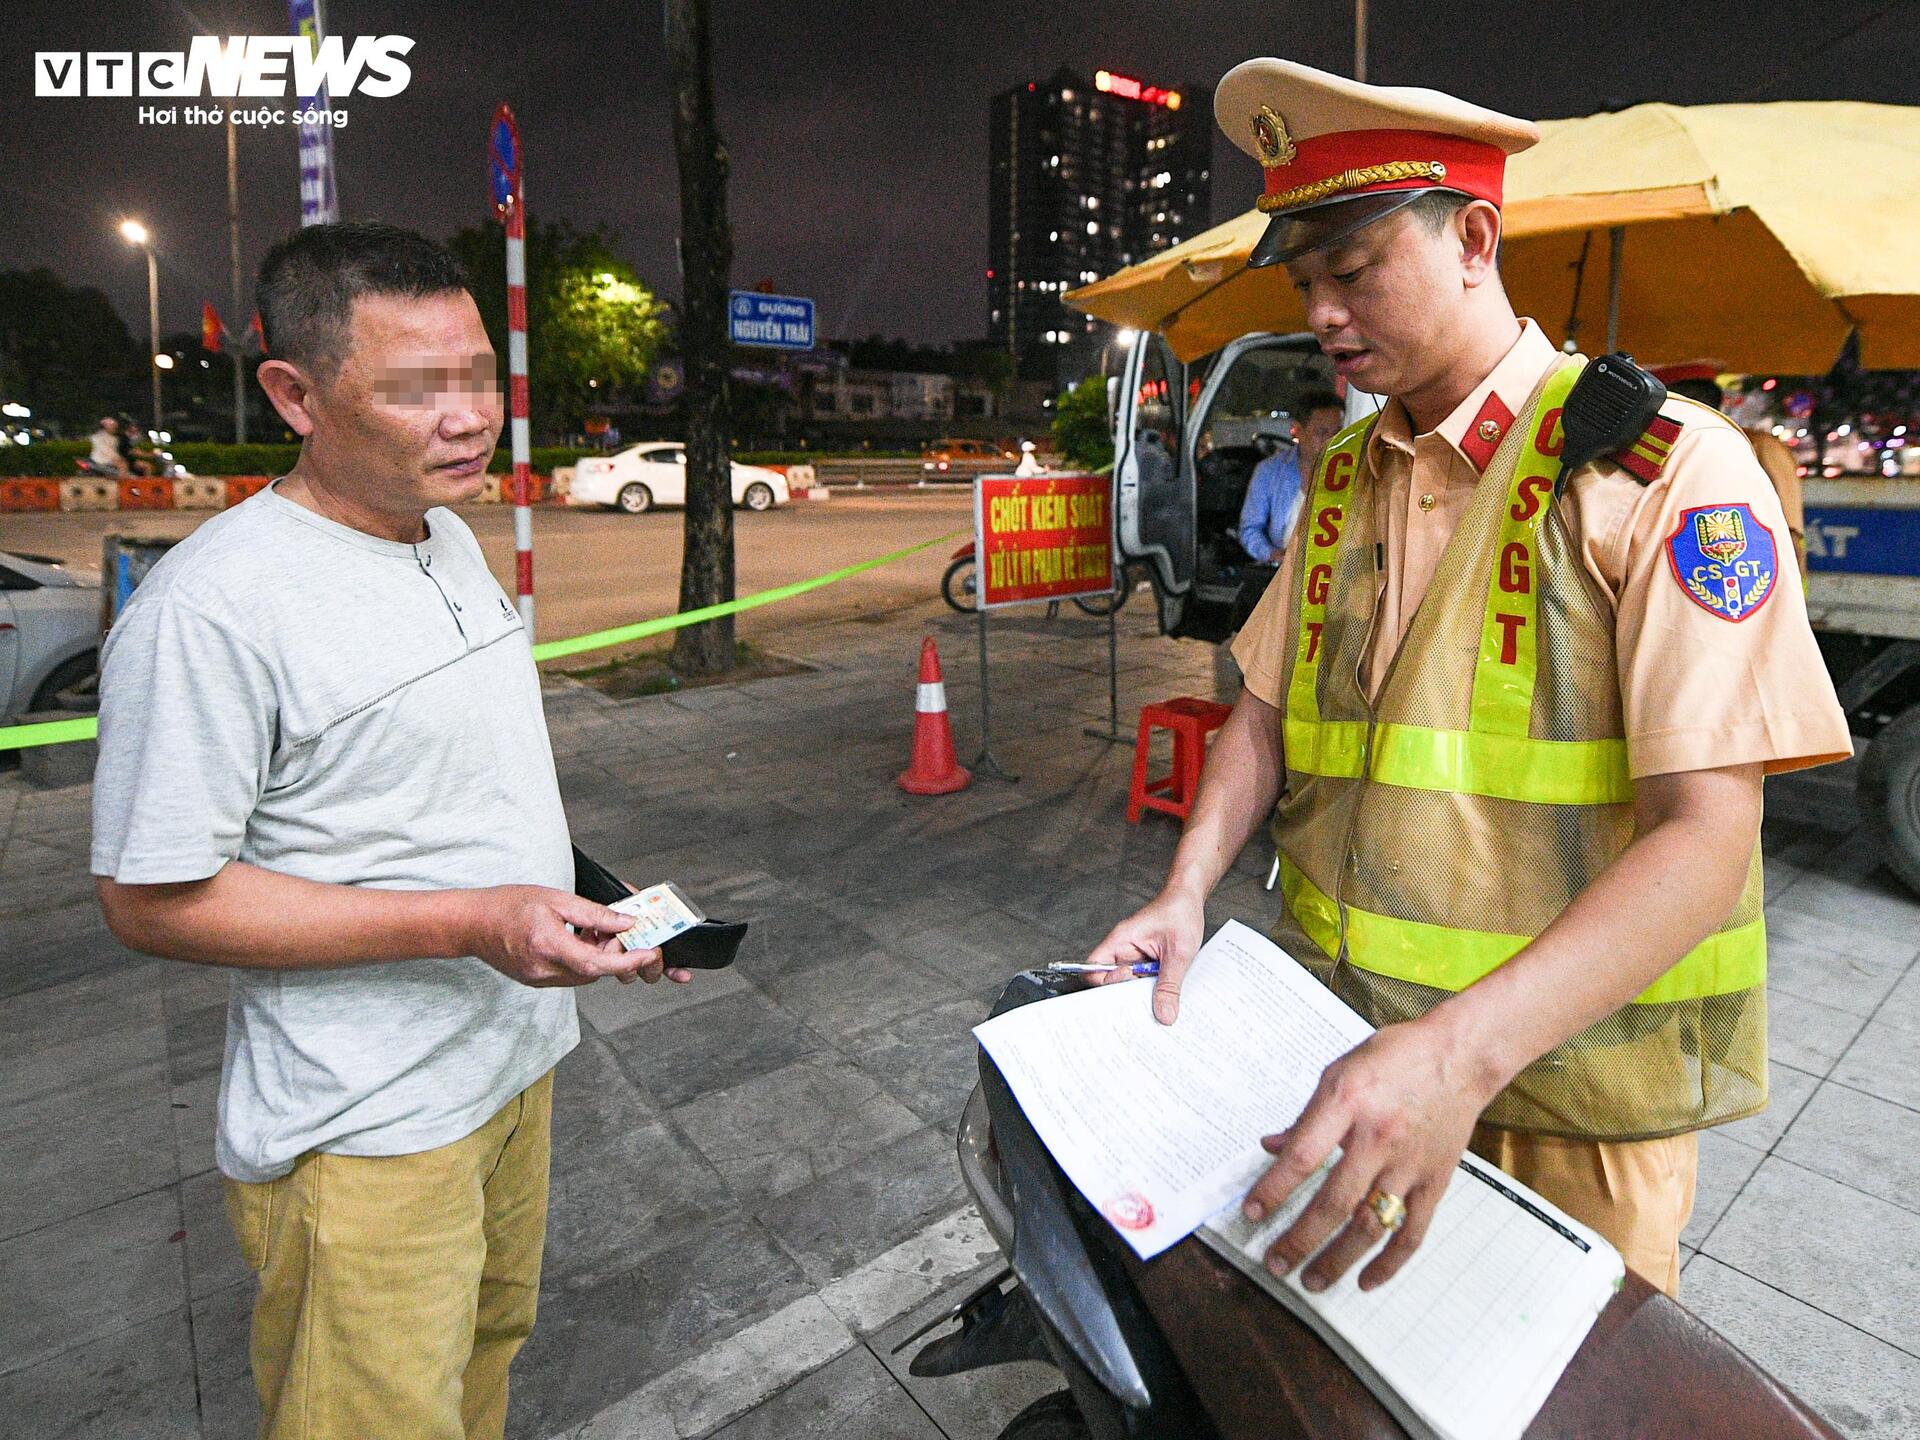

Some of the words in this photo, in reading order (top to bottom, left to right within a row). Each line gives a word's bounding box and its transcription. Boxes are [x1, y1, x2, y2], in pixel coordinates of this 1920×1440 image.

[1607, 370, 1638, 390] MOTOROLA
[990, 482, 1027, 533] CHỐT
[1031, 480, 1068, 531] KIỂM
[1693, 564, 1723, 582] CS
[1735, 560, 1761, 578] GT
